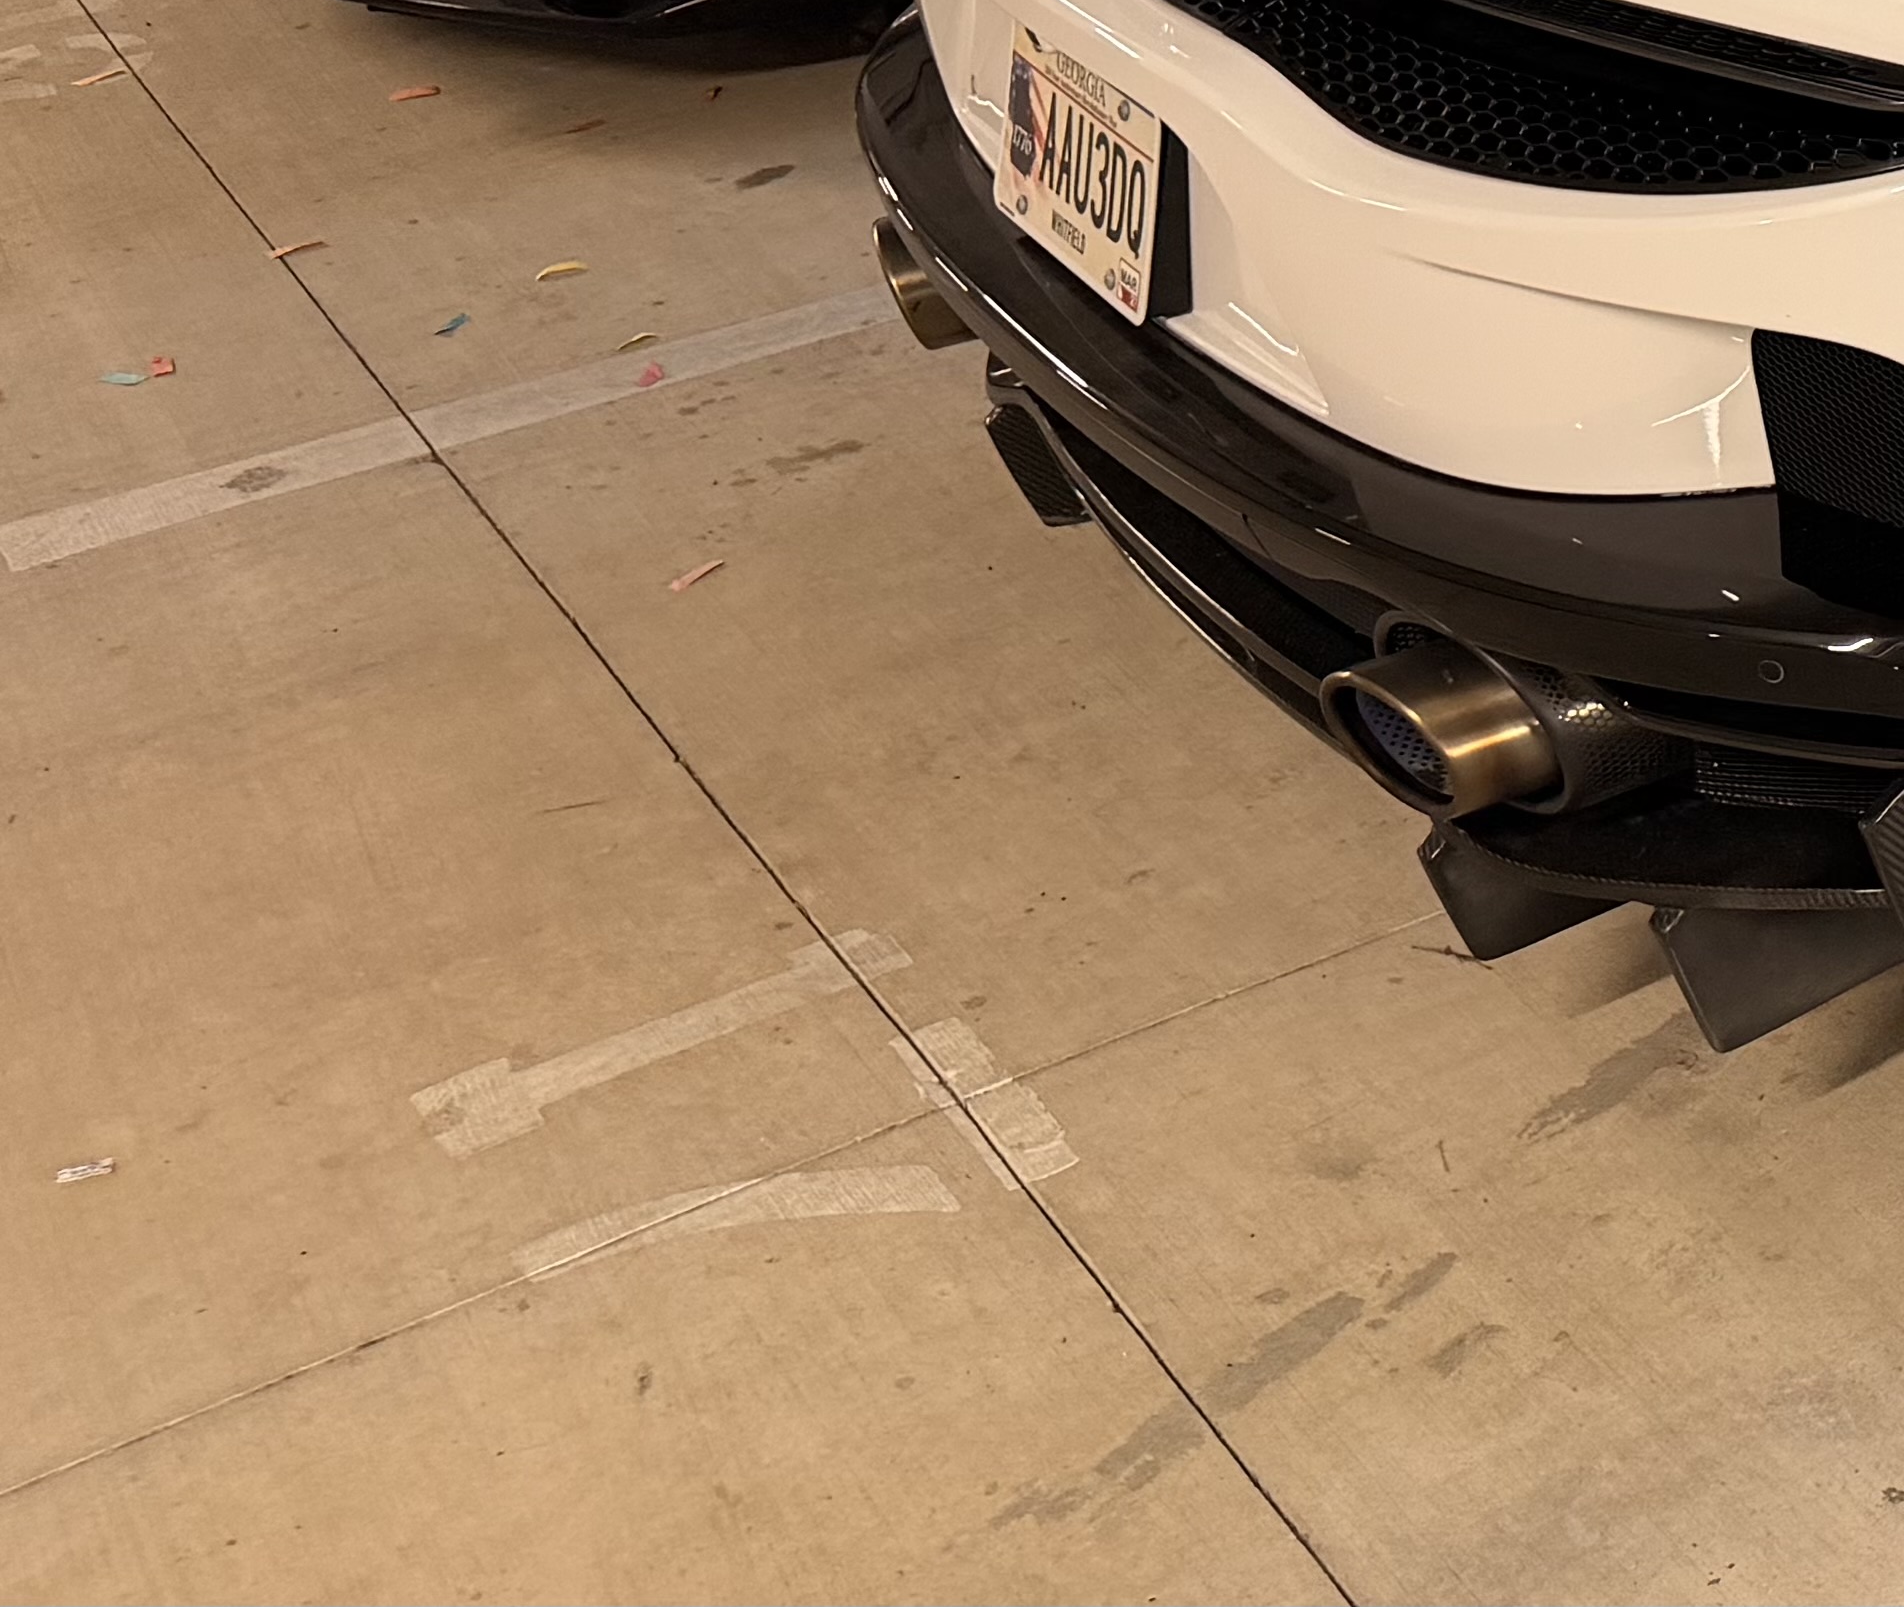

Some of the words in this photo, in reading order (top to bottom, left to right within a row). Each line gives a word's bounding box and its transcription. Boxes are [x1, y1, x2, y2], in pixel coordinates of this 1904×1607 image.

[1056, 52, 1106, 108] GEORGIA
[1039, 92, 1147, 260] AAU3DQ
[1051, 209, 1086, 255] WHITFIELD
[1120, 268, 1138, 293] MAR
